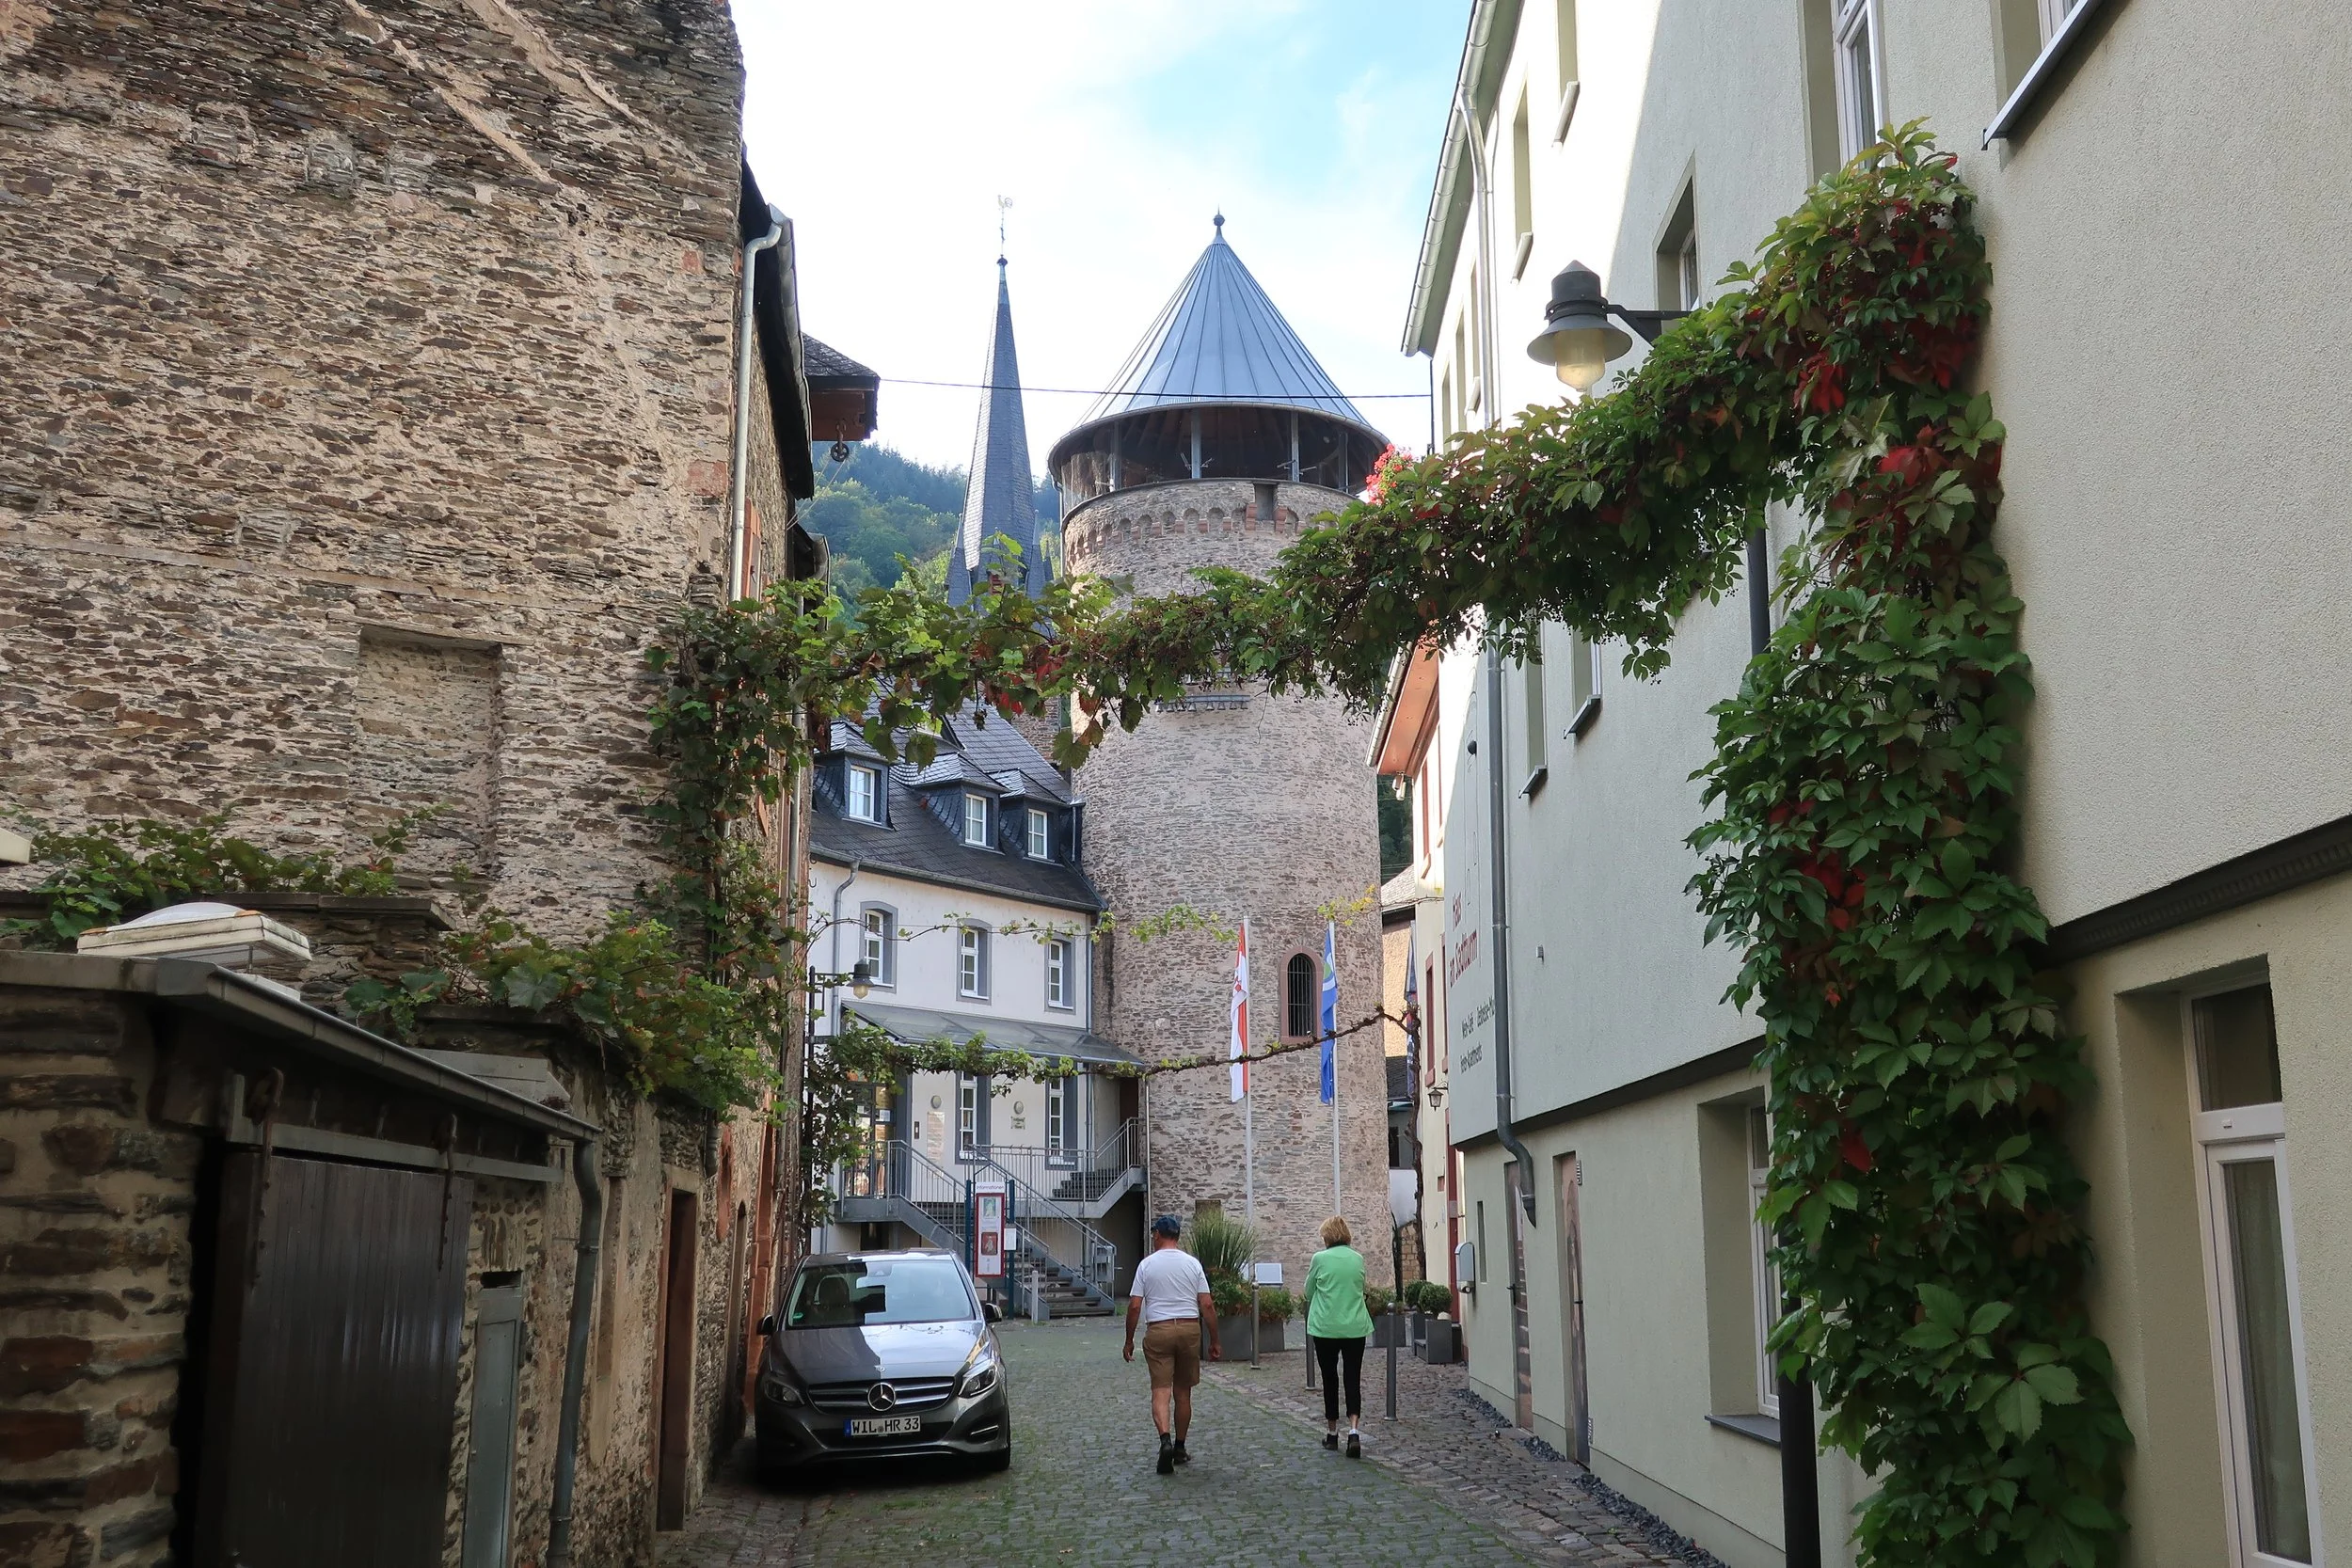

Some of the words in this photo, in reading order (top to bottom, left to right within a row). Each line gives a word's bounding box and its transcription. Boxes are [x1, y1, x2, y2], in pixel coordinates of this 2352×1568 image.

[851, 1420, 877, 1433] WIL
[884, 1418, 901, 1433] HR
[904, 1417, 919, 1431] 33
